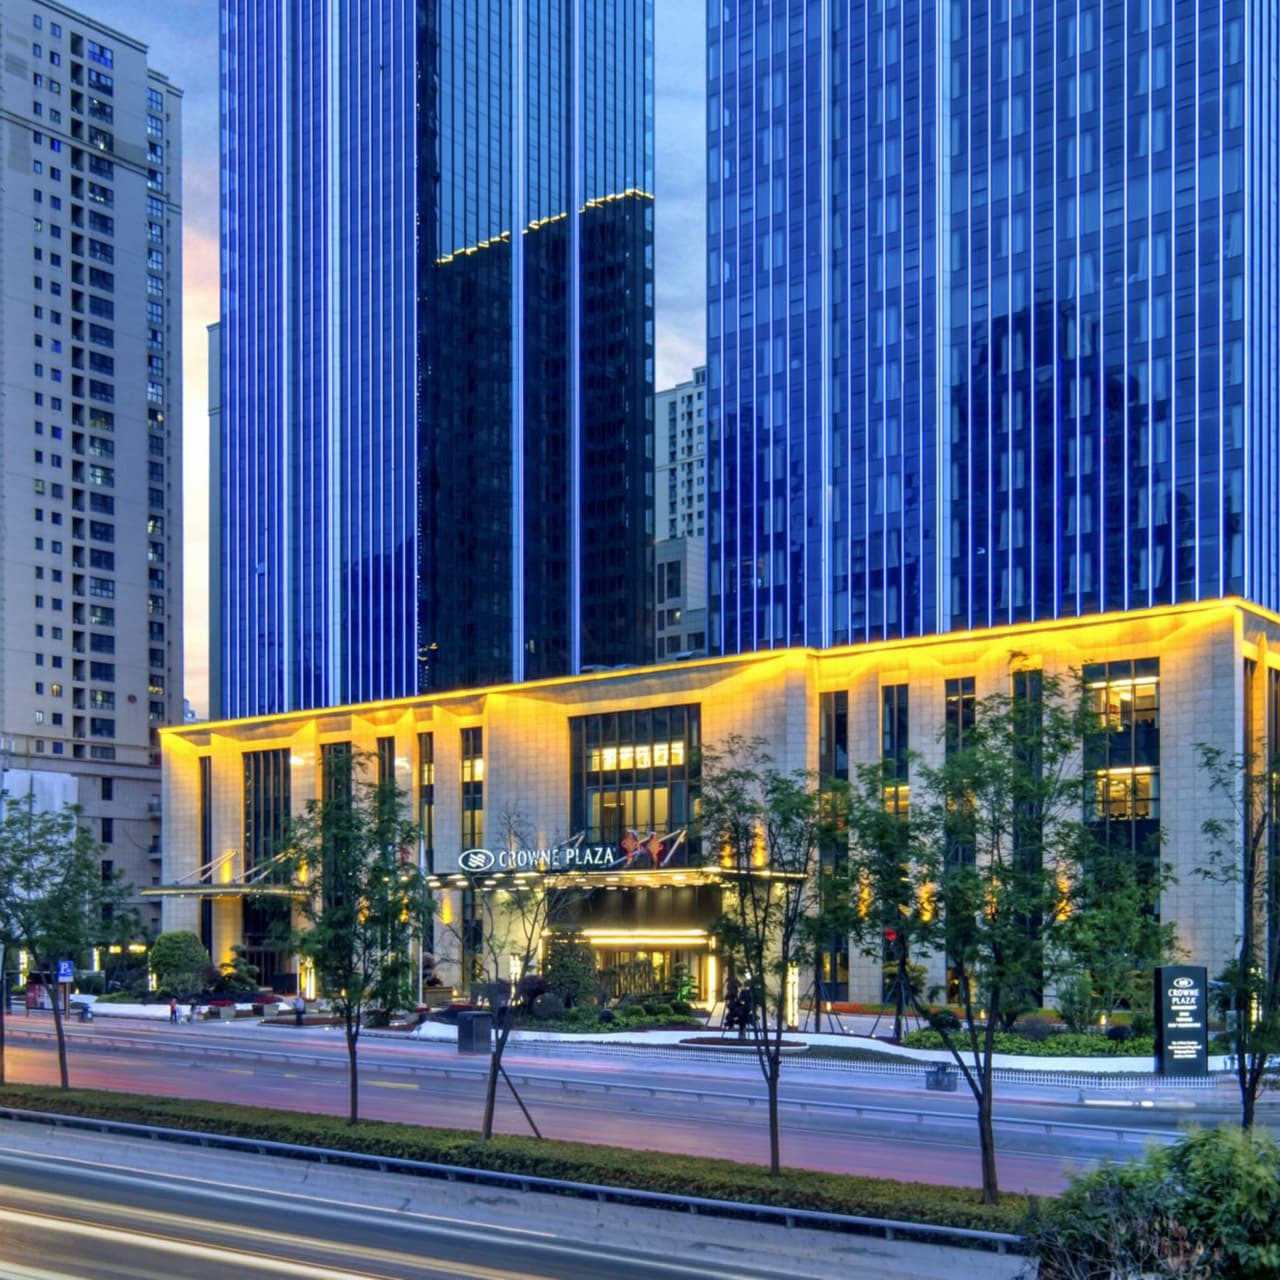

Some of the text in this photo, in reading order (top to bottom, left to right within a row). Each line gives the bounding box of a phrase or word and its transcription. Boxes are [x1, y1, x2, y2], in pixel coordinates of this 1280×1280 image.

[498, 847, 614, 868] CROWNE PLAZA
[1167, 988, 1200, 997] CROWNE
[1171, 997, 1196, 1005] PLAZA
